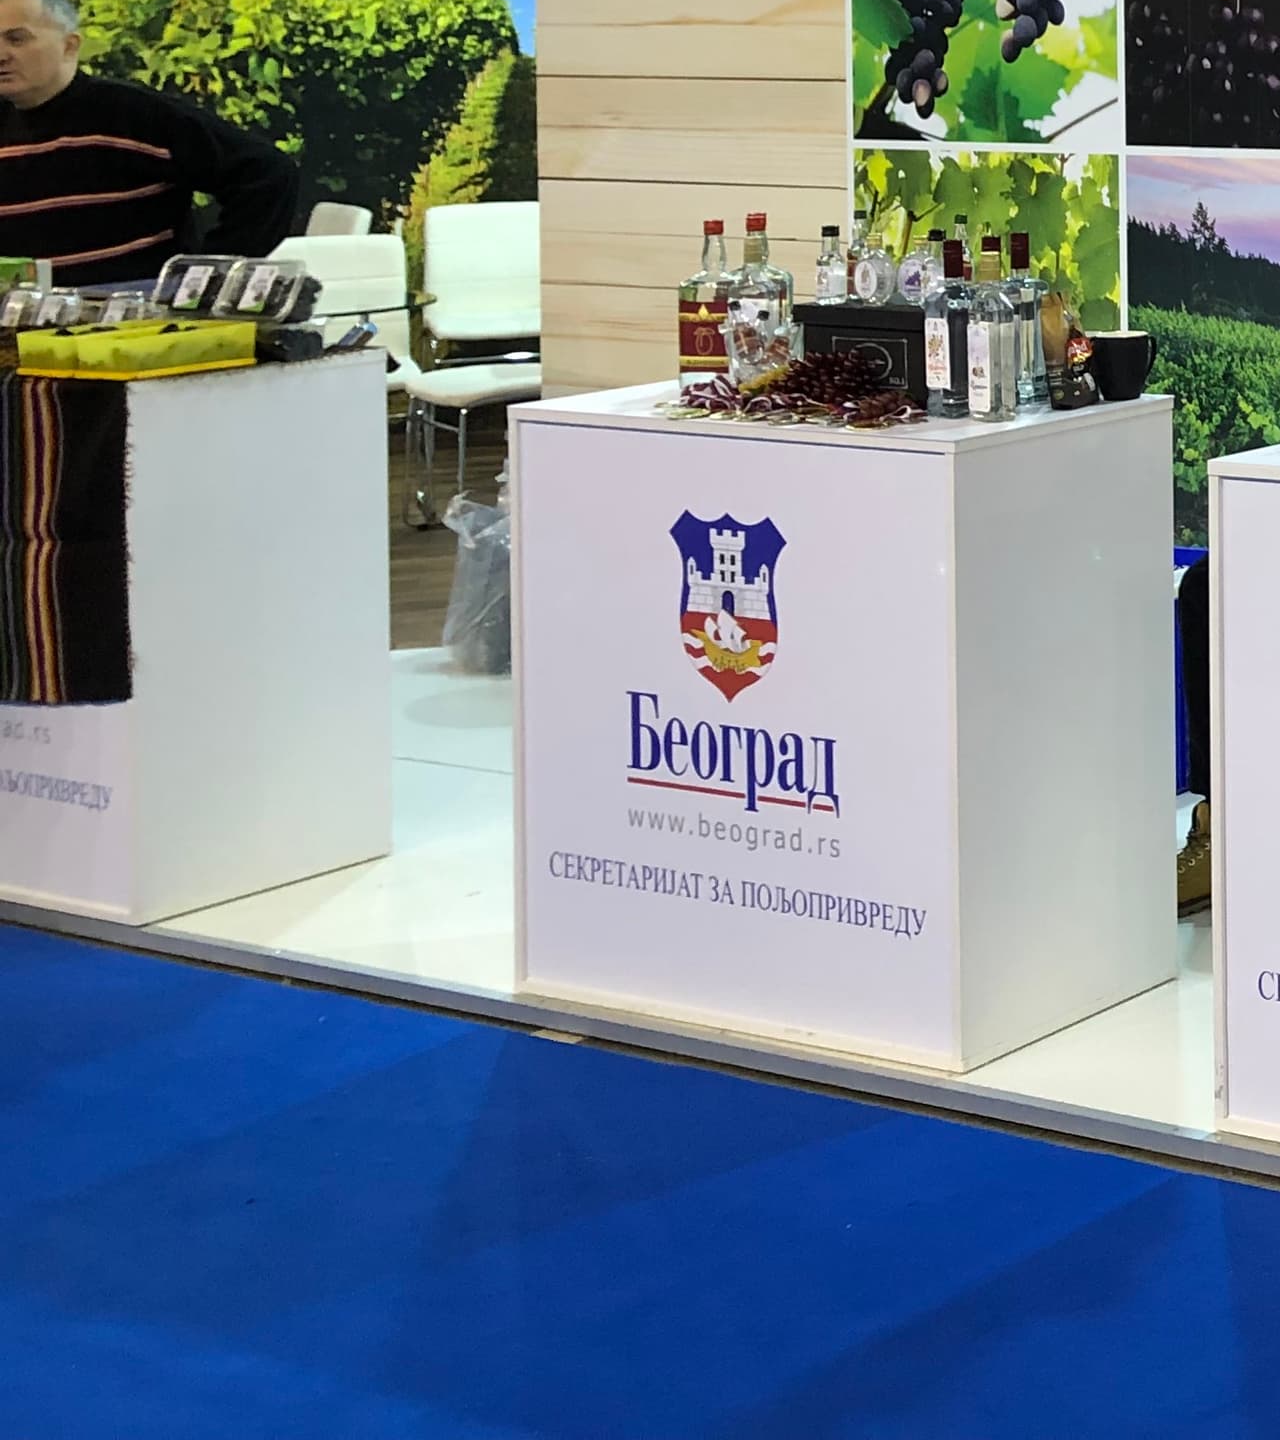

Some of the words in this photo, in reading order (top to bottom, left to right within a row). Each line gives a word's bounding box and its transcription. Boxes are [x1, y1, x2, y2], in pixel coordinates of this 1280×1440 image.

[625, 690, 841, 817] Београд
[627, 806, 841, 858] www.beograd.rs
[549, 850, 703, 903] СЕКРЕТАРИЈАТ
[708, 875, 735, 906] ЗА
[740, 880, 927, 940] ПОЉОПРИВРЕДУ
